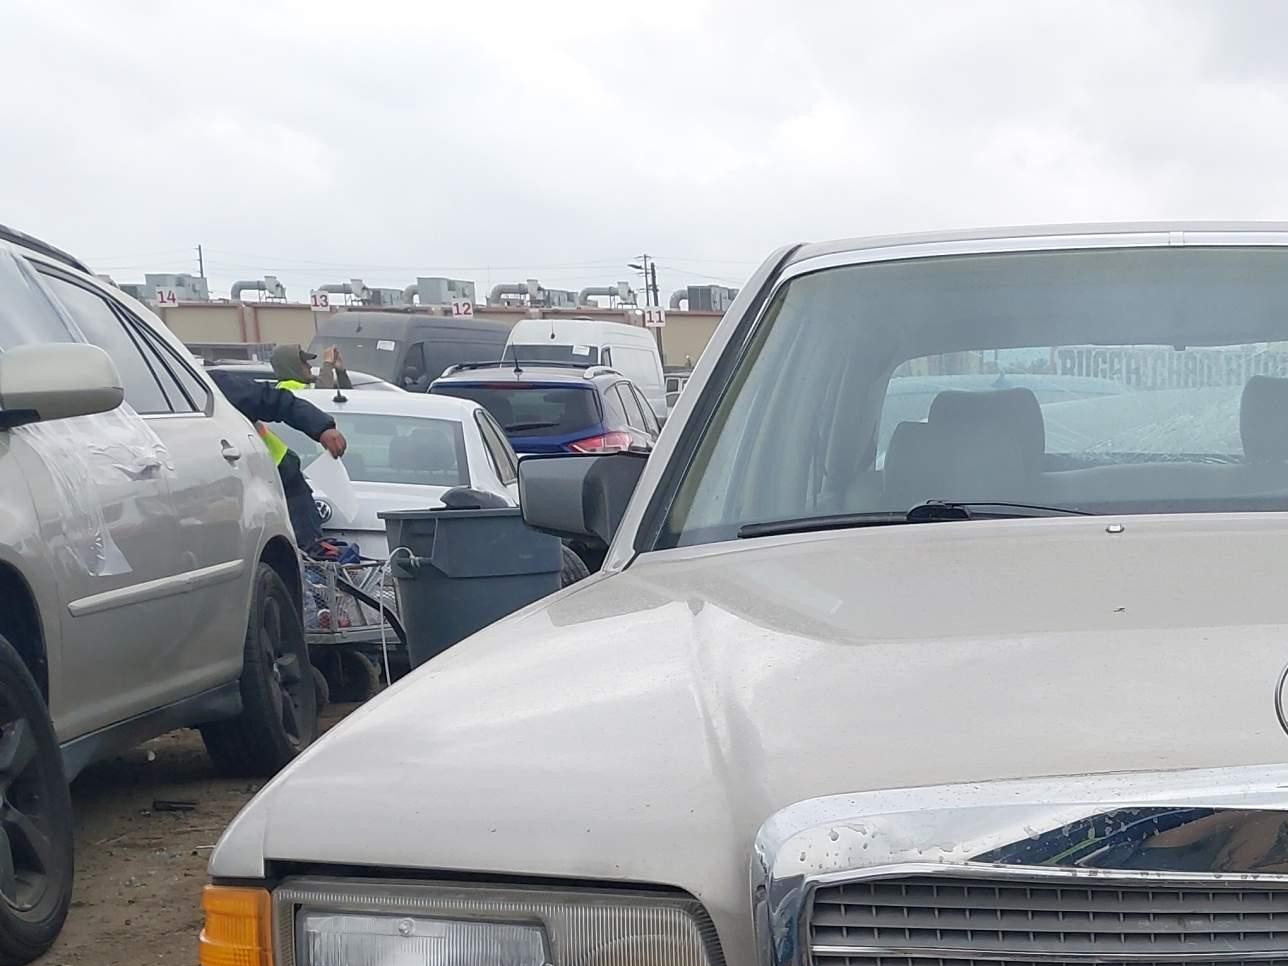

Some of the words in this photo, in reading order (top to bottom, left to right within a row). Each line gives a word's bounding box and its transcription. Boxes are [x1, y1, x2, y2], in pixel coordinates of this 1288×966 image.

[157, 290, 176, 304] 14
[311, 294, 329, 307] 13
[453, 302, 472, 315] 12
[646, 310, 664, 323] 11
